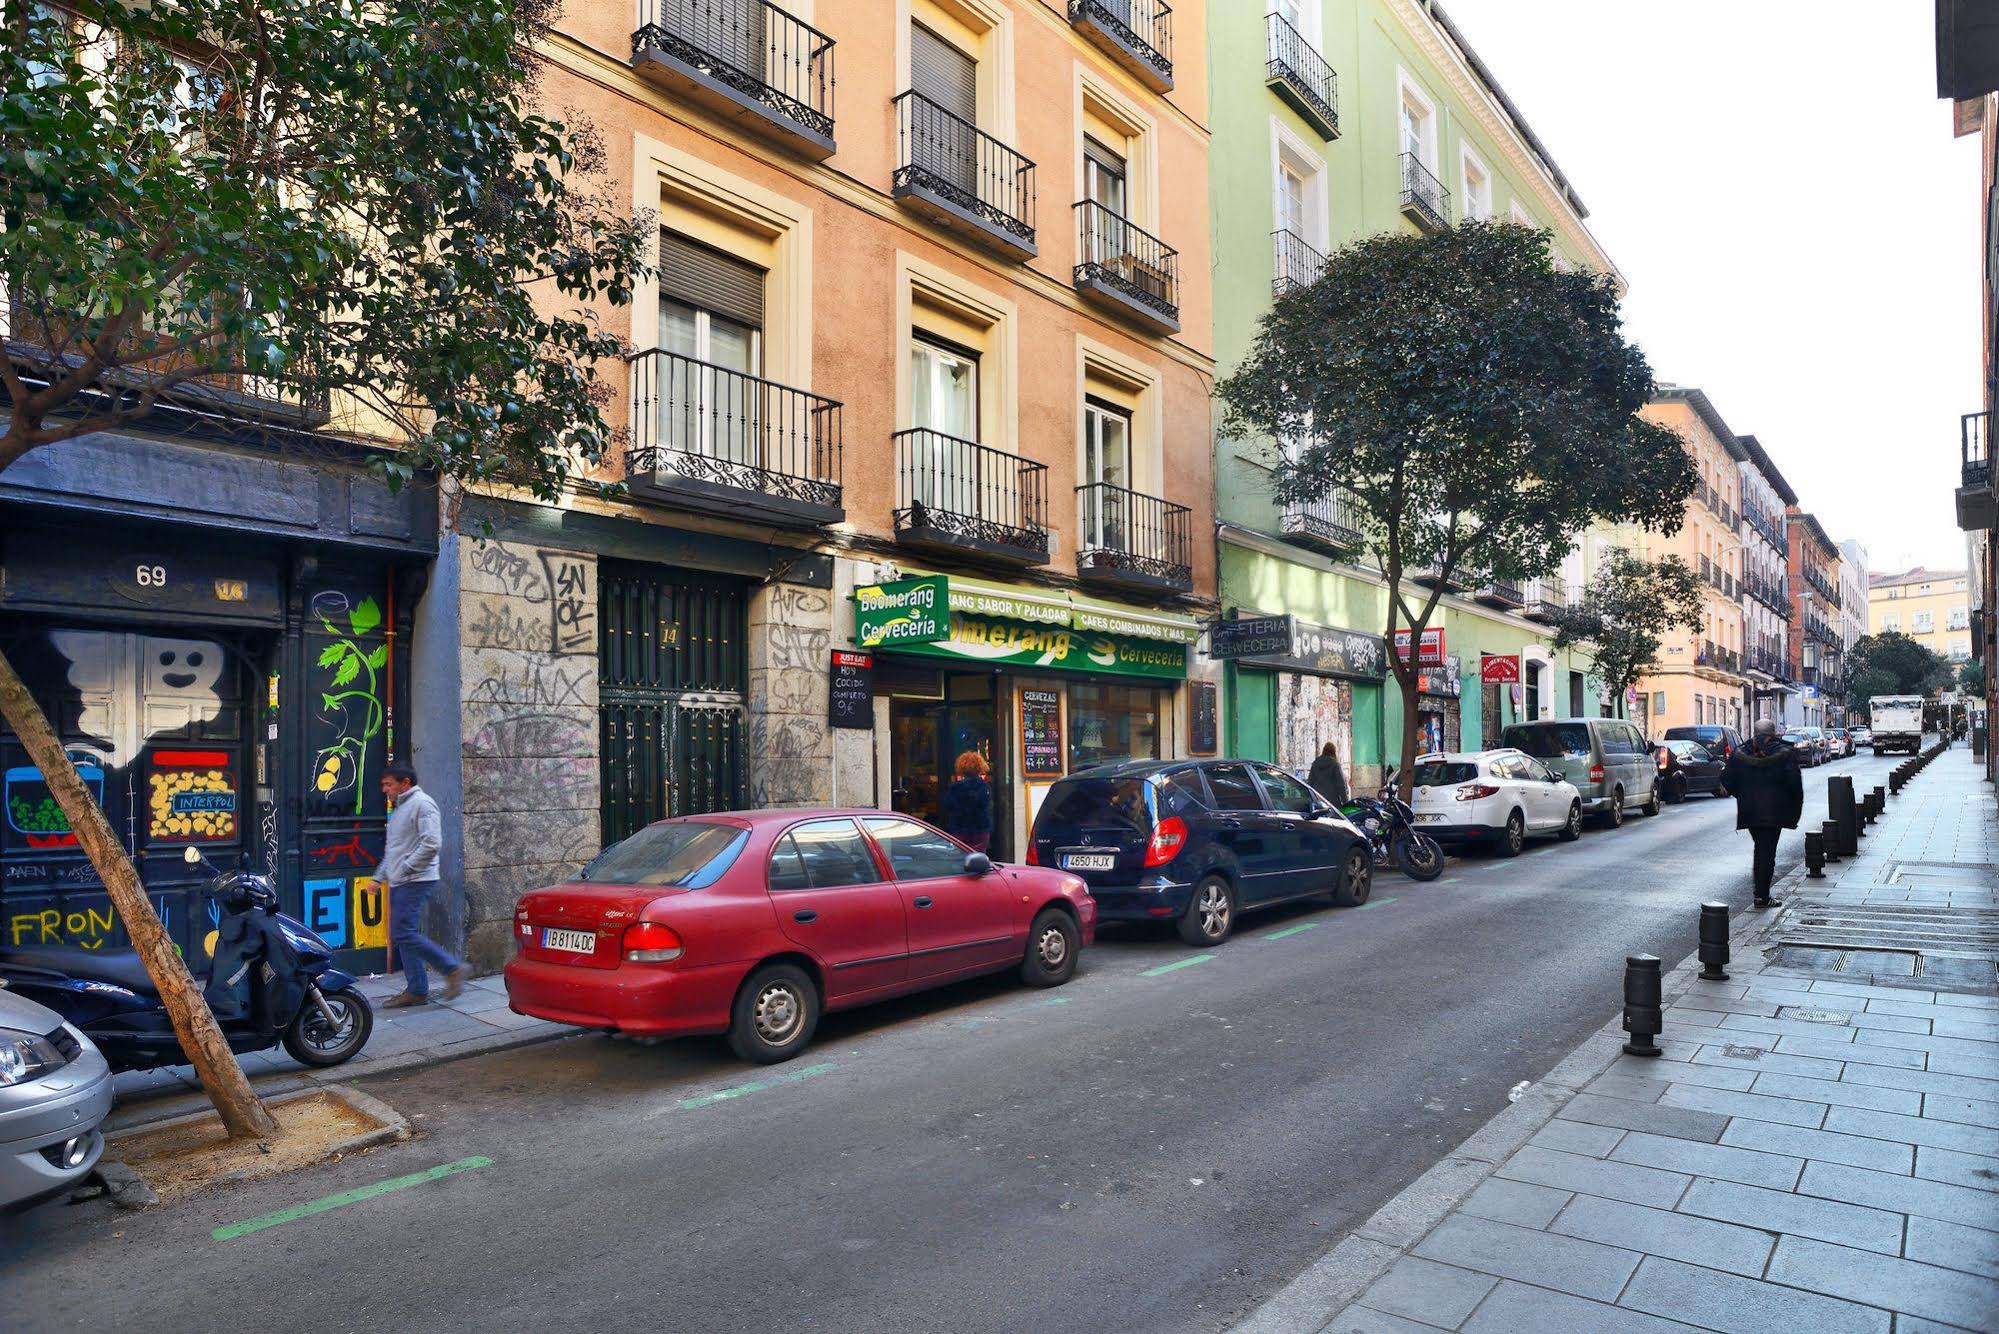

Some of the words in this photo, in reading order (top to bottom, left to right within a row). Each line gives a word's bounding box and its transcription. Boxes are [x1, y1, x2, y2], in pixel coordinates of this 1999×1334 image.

[136, 565, 166, 587] 69
[861, 588, 935, 612] Boomerang
[977, 598, 1013, 614] SABOR
[1015, 603, 1023, 613] Y
[1024, 605, 1068, 622] PALADAR
[861, 615, 935, 641] Cervecería
[1081, 614, 1108, 628] CAFES
[1109, 618, 1161, 637] COMBINADOS
[1162, 629, 1169, 637] Y
[1169, 630, 1185, 641] MAS
[1213, 620, 1287, 639] CAFETERIA
[662, 628, 677, 643] 14
[1213, 637, 1288, 655] CERVECERIA
[840, 654, 854, 662] JUST
[841, 666, 856, 676] HOY
[835, 678, 865, 688] COCIDO
[1024, 691, 1057, 703] CERVEZAS
[1804, 687, 1815, 698] P
[180, 795, 233, 809] INTERPOL
[1070, 856, 1090, 867] 4650
[1092, 857, 1110, 867] HJX
